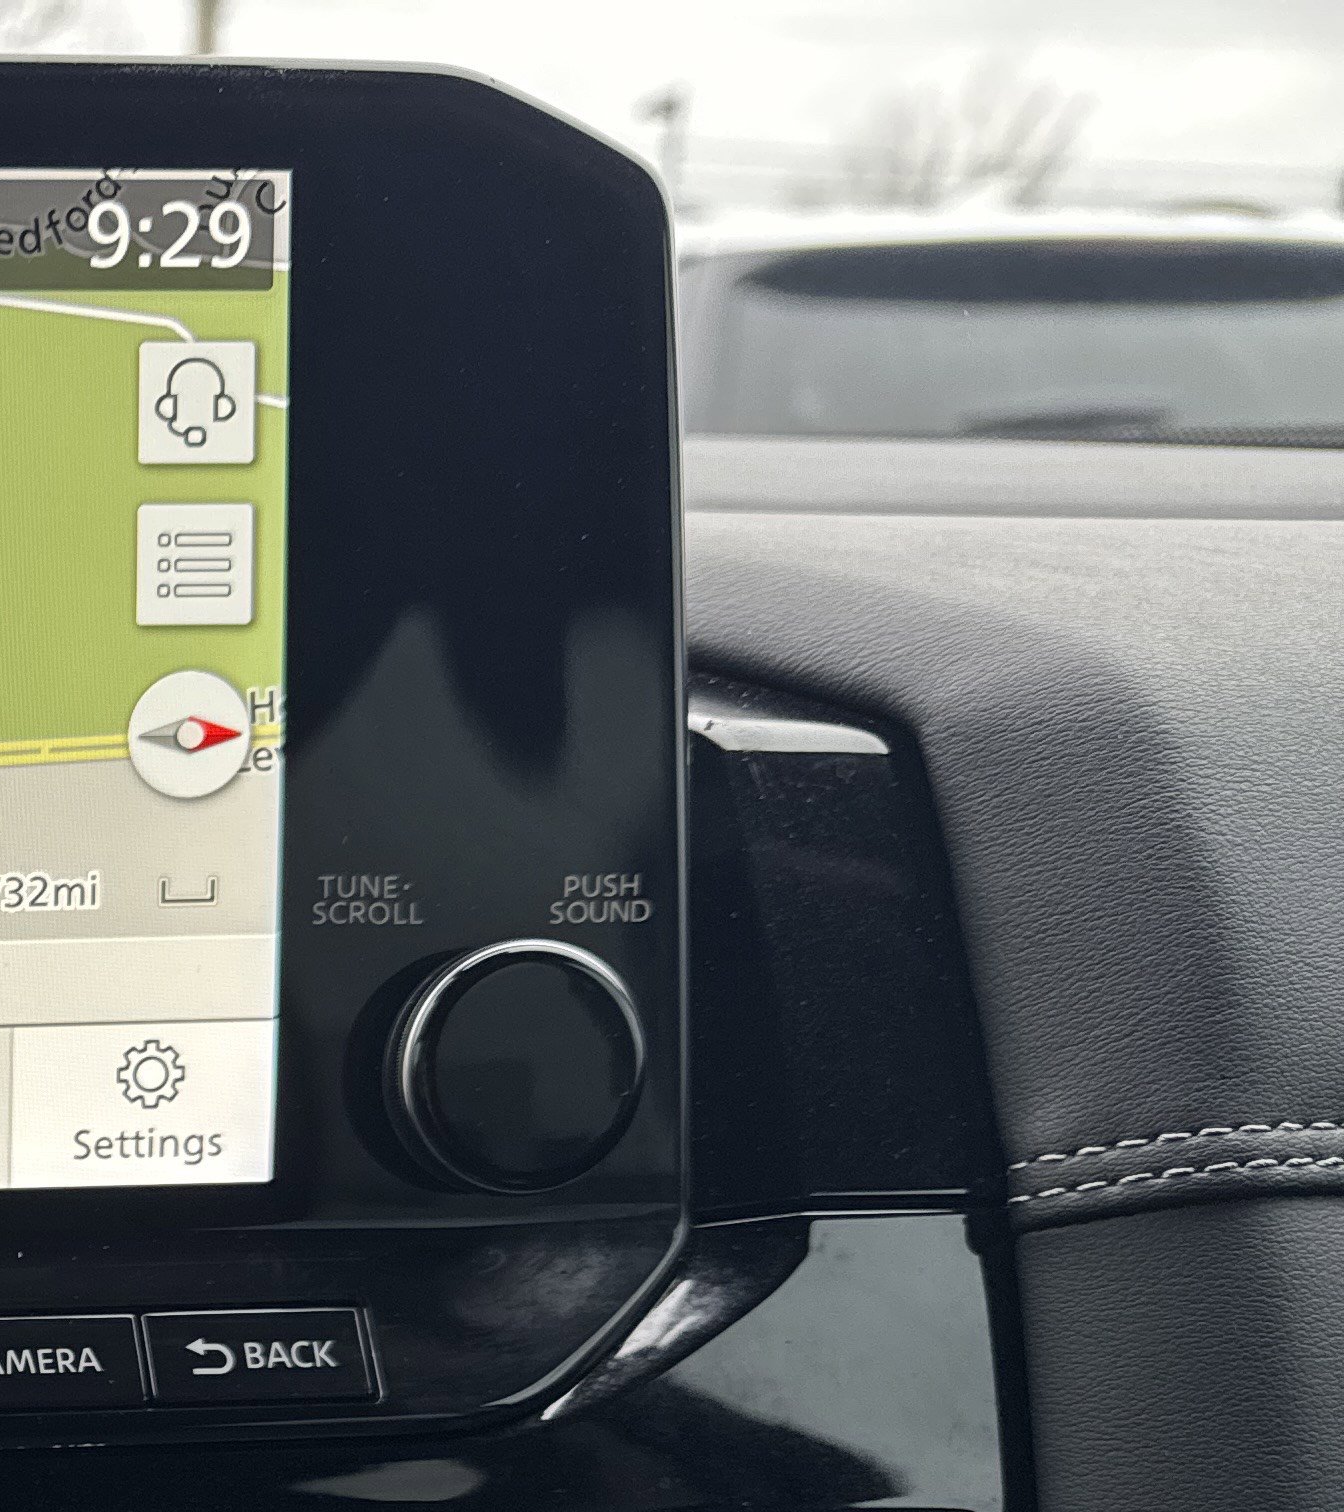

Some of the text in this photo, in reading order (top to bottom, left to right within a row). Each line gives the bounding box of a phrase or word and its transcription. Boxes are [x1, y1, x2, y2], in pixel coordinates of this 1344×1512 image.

[86, 199, 252, 269] 9:29
[562, 873, 642, 898] PUSH
[312, 900, 424, 925] SCROLL
[549, 900, 652, 925] SOUND
[73, 1129, 224, 1164] Settings
[242, 1340, 338, 1370] BACK
